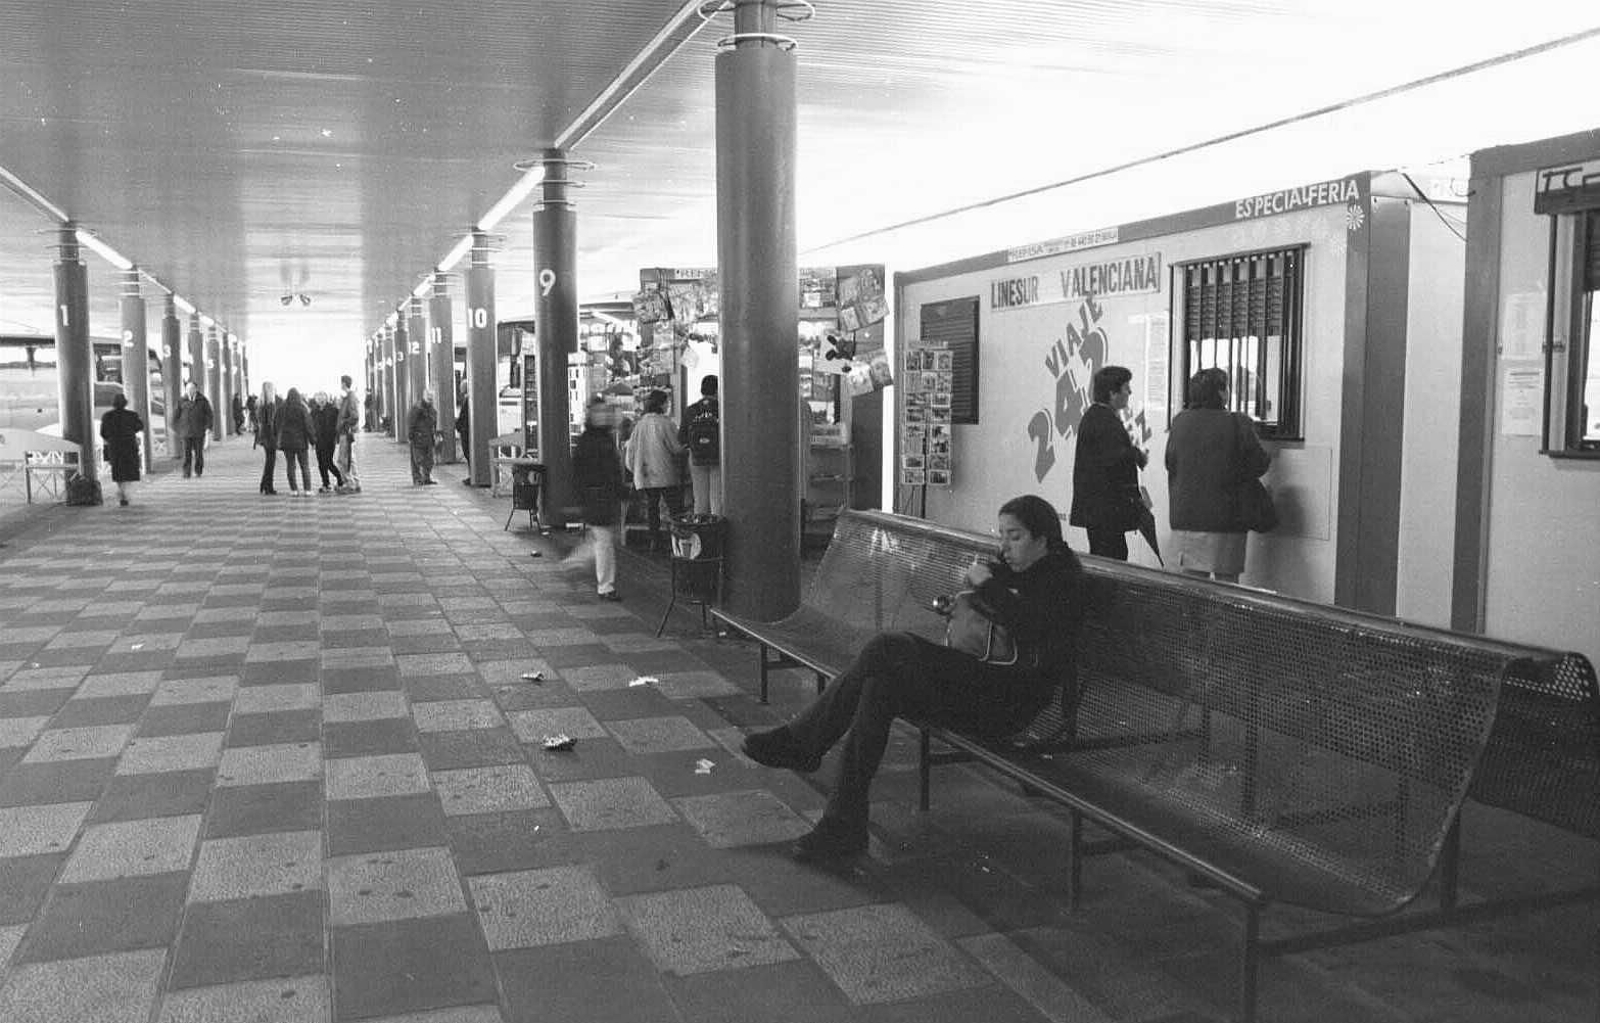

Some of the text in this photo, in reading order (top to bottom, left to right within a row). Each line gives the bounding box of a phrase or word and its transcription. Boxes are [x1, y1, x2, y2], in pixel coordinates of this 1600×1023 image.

[540, 269, 556, 297] 9
[991, 256, 1158, 309] LINESUR VALENCIANA
[60, 304, 69, 327] 1
[467, 307, 488, 328] 10
[123, 330, 134, 348] 2
[431, 327, 442, 344] 11
[1045, 294, 1103, 379] VIAJE
[163, 344, 172, 358] 3
